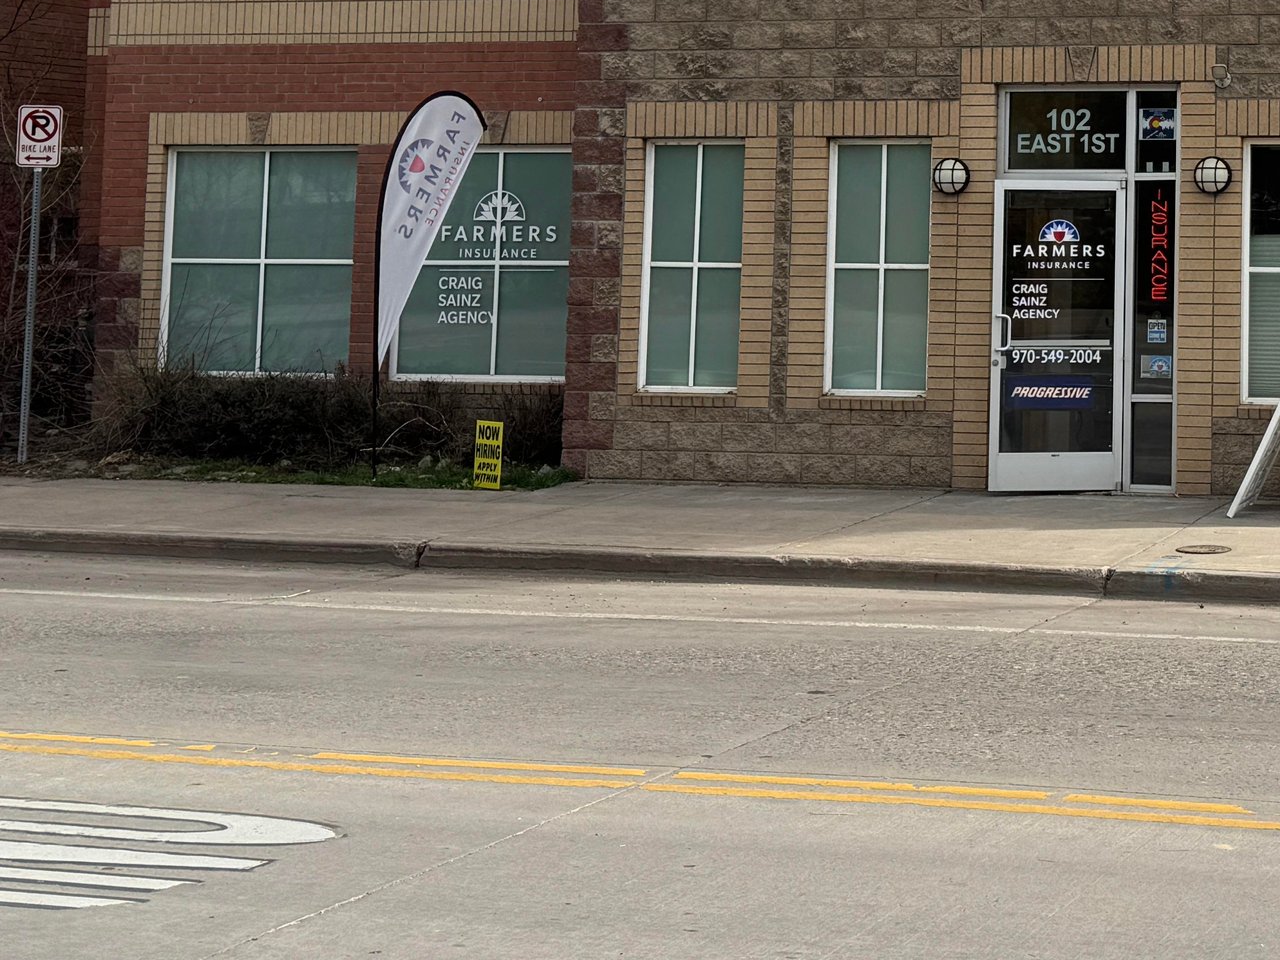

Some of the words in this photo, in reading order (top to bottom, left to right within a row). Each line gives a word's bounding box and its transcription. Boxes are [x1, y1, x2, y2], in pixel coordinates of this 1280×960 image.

[1046, 108, 1091, 131] 102
[21, 144, 37, 153] BIKE
[39, 145, 57, 153] LANE
[1017, 134, 1075, 154] EAST
[1080, 134, 1120, 154] 1ST
[441, 225, 557, 242] FARMERS
[1012, 244, 1106, 257] FARMERS
[1151, 188, 1168, 300] INSURANCE
[1027, 261, 1091, 269] INSURANCE
[438, 276, 483, 290] CRAIG
[1012, 284, 1048, 294] CRAIG
[438, 293, 481, 307] SAINZ
[1012, 296, 1047, 306] SAINZ
[1012, 309, 1060, 319] AGENCY
[1012, 349, 1102, 364] 970-549-2004
[1011, 386, 1092, 399] PROGRESSIVE
[478, 425, 501, 441] NOW
[476, 442, 501, 460] HIRING
[477, 462, 497, 472] APPLY
[474, 472, 498, 484] WITHIN
